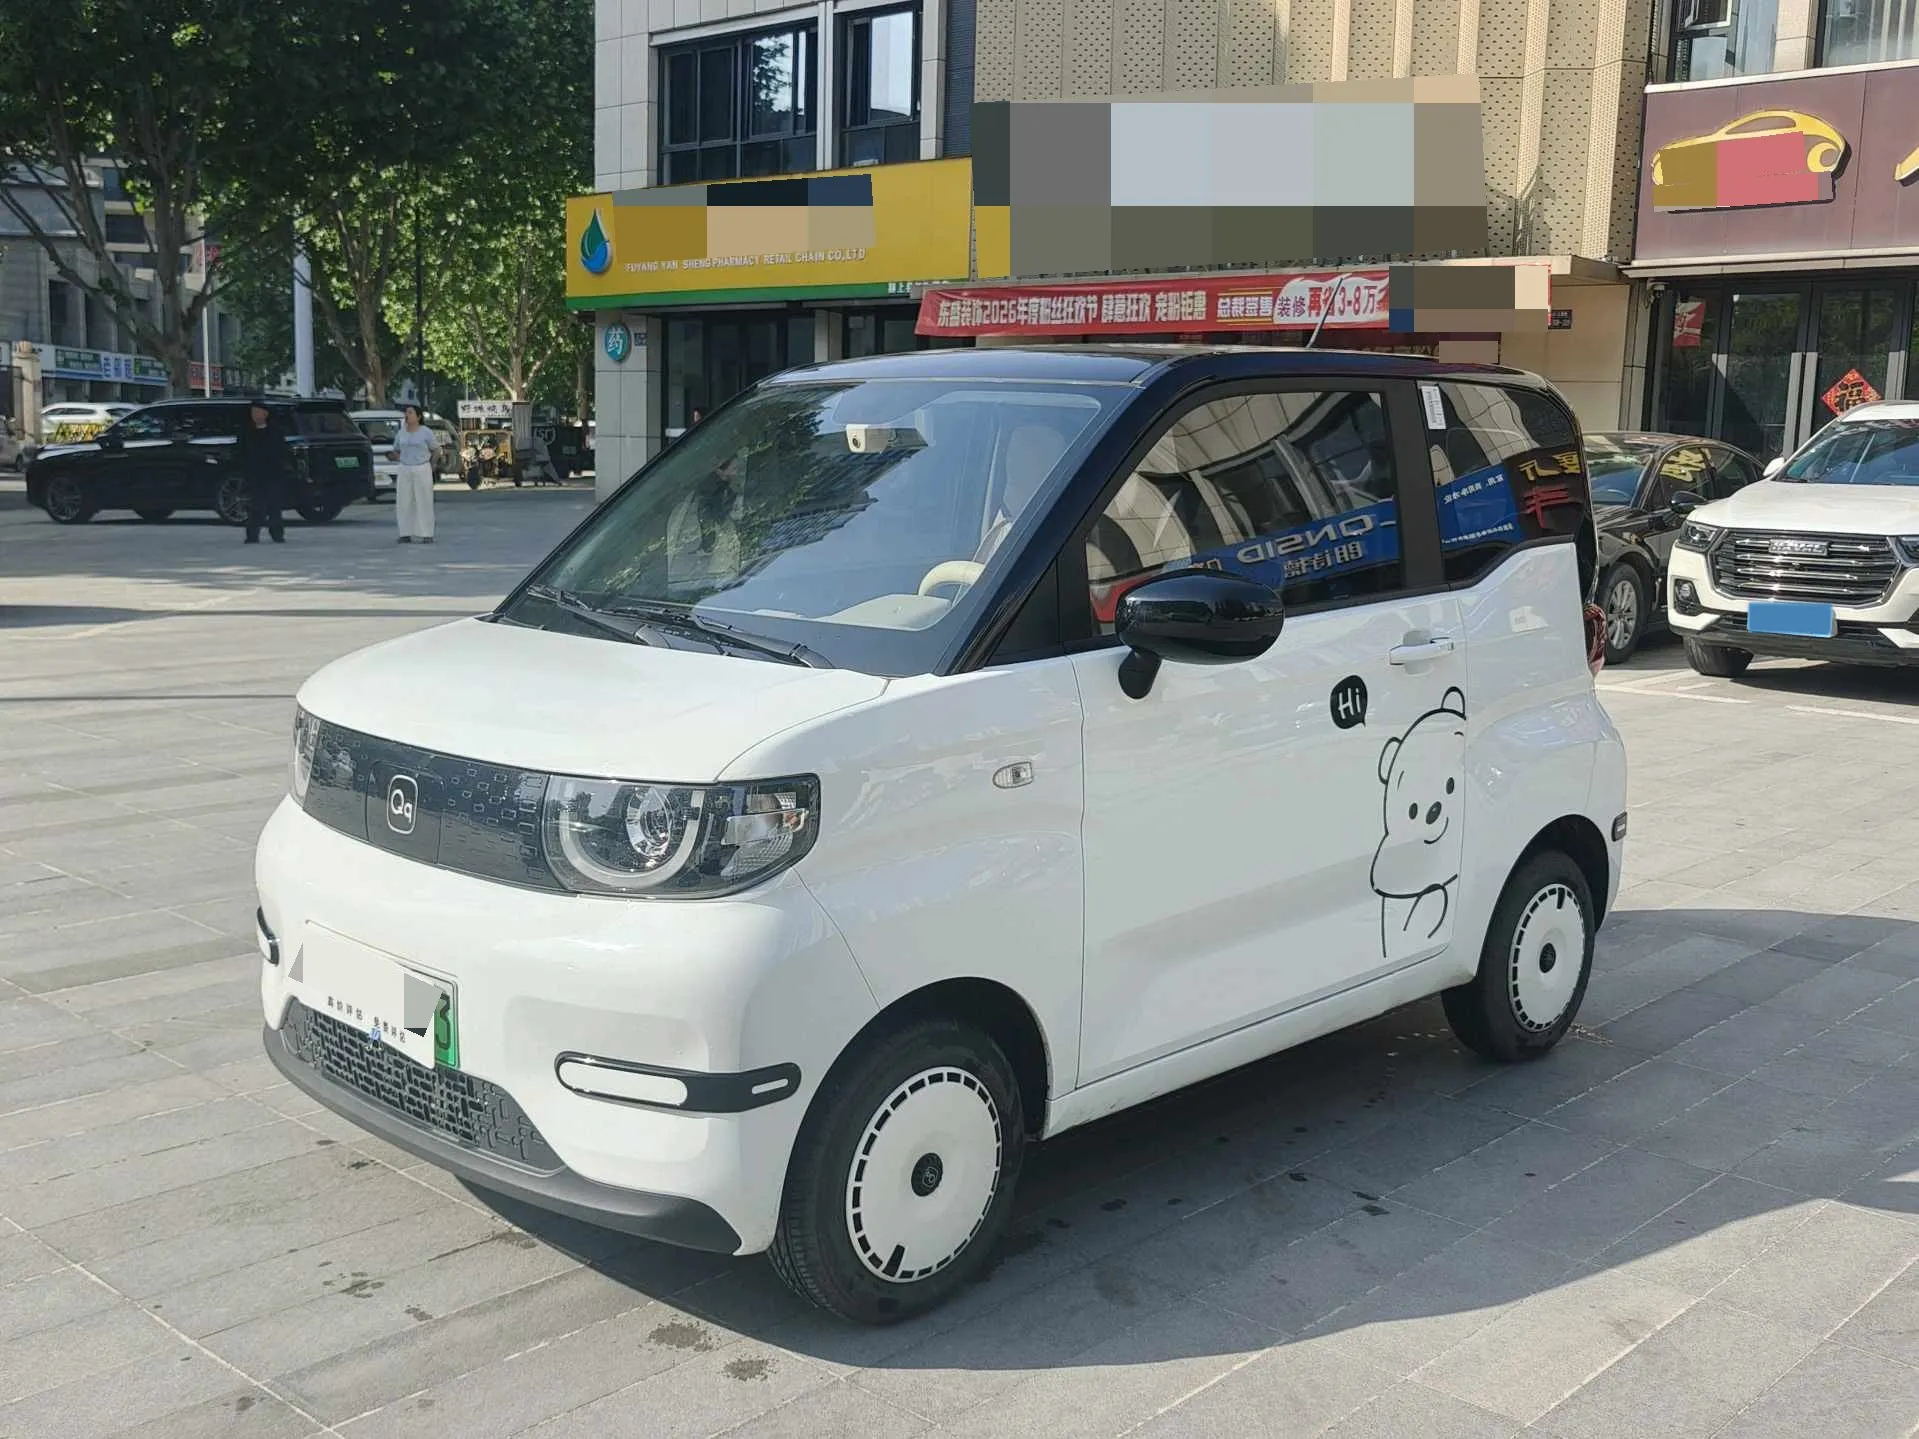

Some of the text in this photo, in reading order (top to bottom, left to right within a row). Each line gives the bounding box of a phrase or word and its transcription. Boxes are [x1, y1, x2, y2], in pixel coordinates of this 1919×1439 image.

[712, 254, 760, 269] PHARMACY
[795, 250, 825, 264] CHAIN
[607, 326, 625, 355] 药
[1834, 381, 1866, 413] 福
[1337, 687, 1361, 721] Hi
